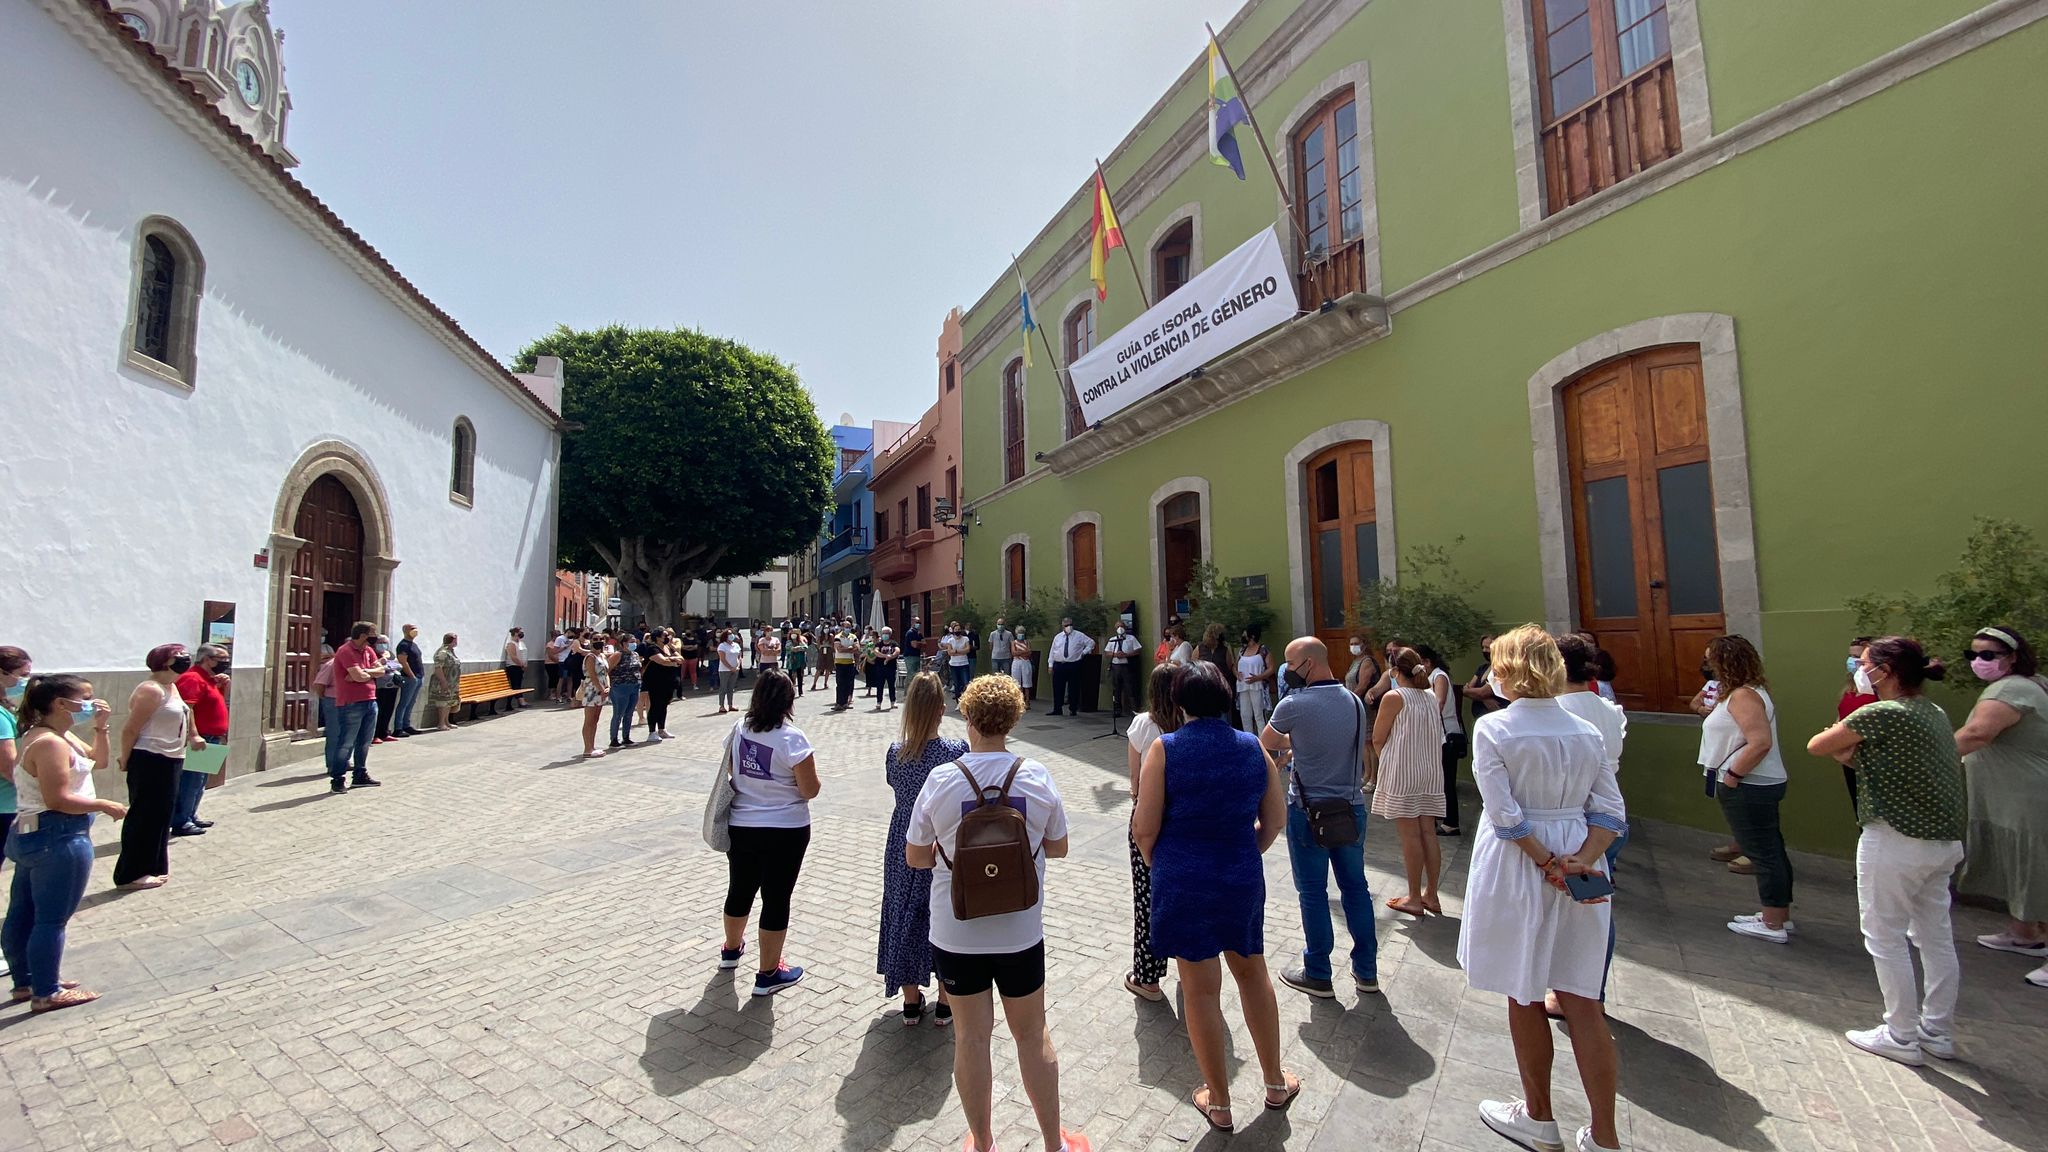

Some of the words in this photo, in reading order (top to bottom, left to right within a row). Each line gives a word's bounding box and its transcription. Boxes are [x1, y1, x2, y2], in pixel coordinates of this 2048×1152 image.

[1082, 375, 1118, 404] CONTRA
[1117, 366, 1131, 384] LA
[1130, 329, 1190, 375] VIOLENCIA
[1191, 315, 1210, 339] DE
[1211, 276, 1277, 326] GÉNERO
[1117, 341, 1142, 364] GUÍA
[1143, 328, 1160, 347] DE
[1162, 302, 1202, 335] ISORA
